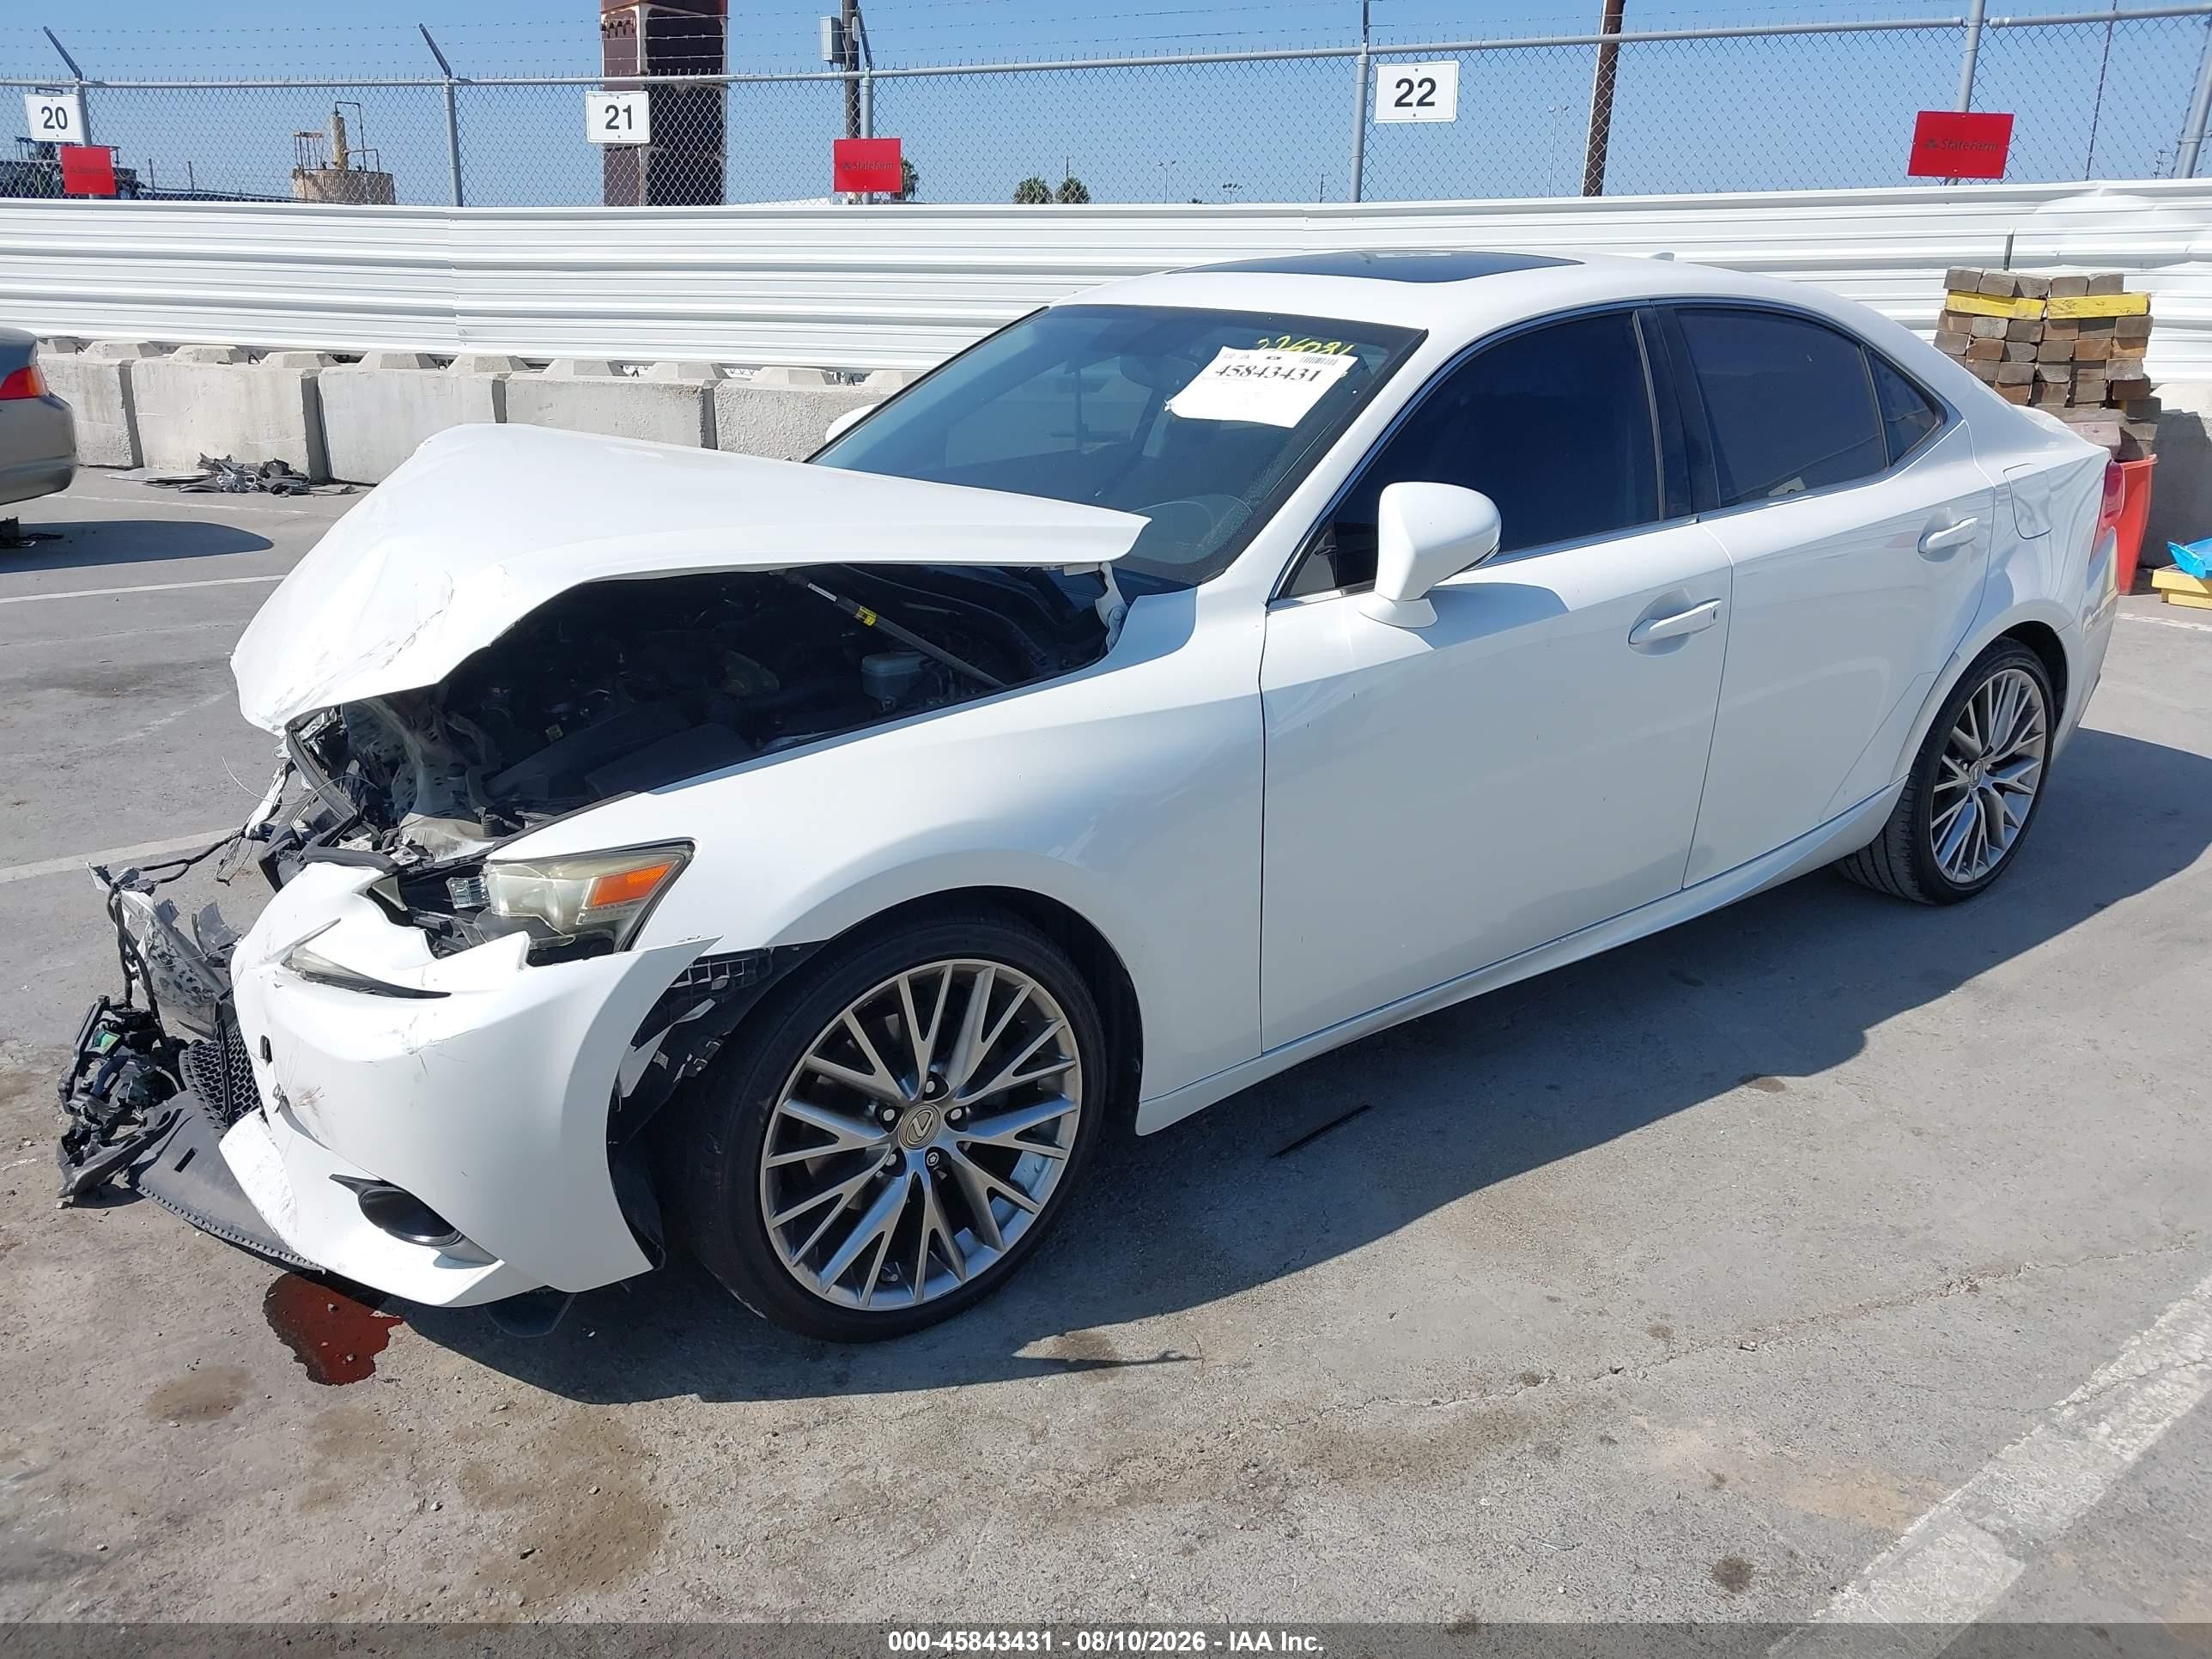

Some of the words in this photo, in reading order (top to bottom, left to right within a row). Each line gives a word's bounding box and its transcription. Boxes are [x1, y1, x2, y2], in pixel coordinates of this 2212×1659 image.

[1394, 77, 1437, 107] 22
[40, 106, 68, 130] 20
[605, 105, 632, 130] 21
[1215, 364, 1322, 382] 45843431
